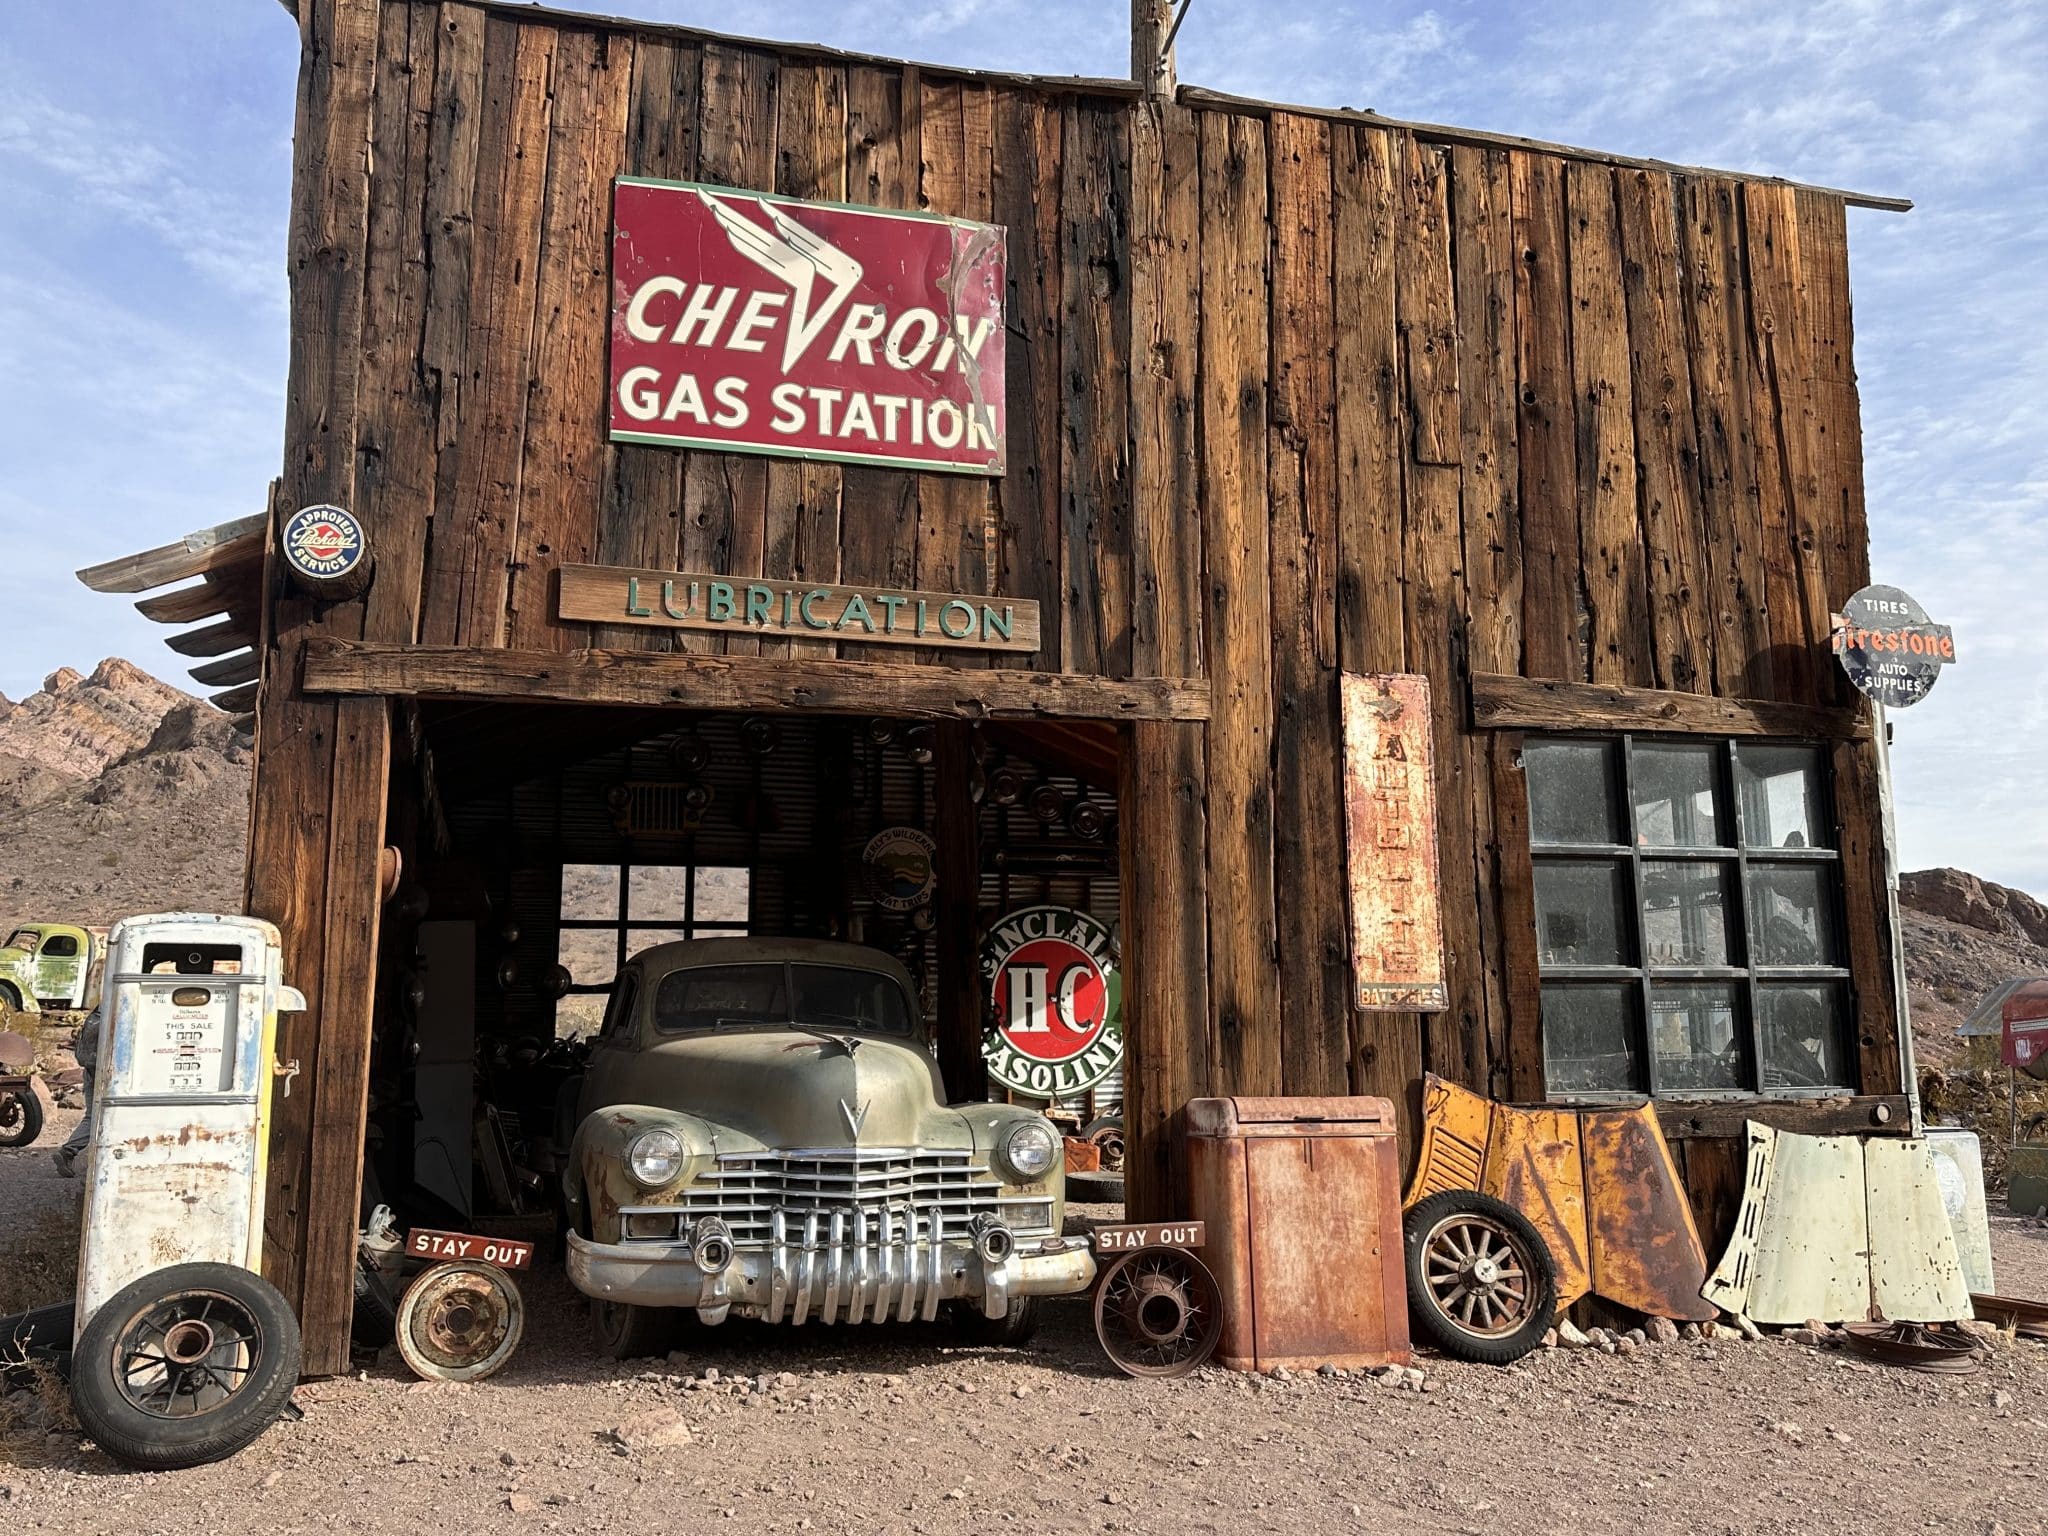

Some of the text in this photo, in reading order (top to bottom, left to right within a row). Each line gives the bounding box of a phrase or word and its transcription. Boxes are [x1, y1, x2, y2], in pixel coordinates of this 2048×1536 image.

[625, 276, 991, 375] CHEVRON
[618, 366, 996, 451] GAS STATION
[299, 510, 354, 535] APPROVED
[290, 527, 357, 549] Packard
[294, 548, 349, 572] SERVICE
[630, 577, 1013, 640] LUBRICATION
[1863, 598, 1909, 615] TIRES
[1877, 663, 1908, 676] AUTO
[1864, 676, 1921, 692] SUPPLIES
[165, 1022, 214, 1030] THIS SALE
[1100, 1227, 1198, 1248] STAY OUT
[415, 1235, 528, 1265] STAY OUT
